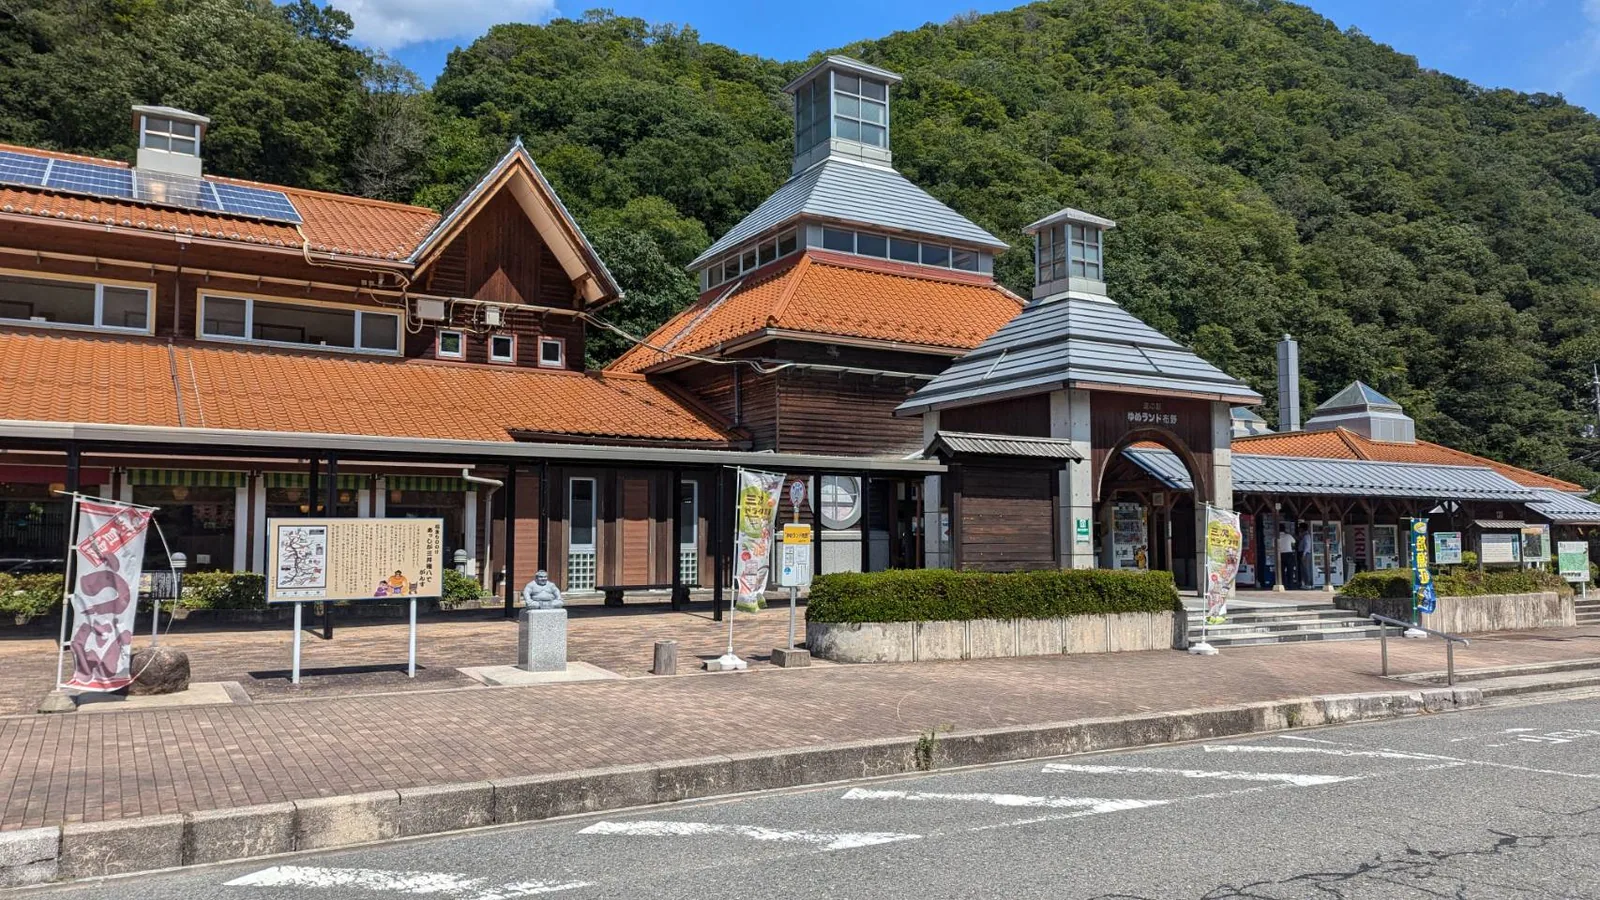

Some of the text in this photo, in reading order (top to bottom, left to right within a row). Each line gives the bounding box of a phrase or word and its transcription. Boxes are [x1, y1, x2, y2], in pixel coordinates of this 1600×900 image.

[1127, 411, 1178, 425] ゆめランド布野
